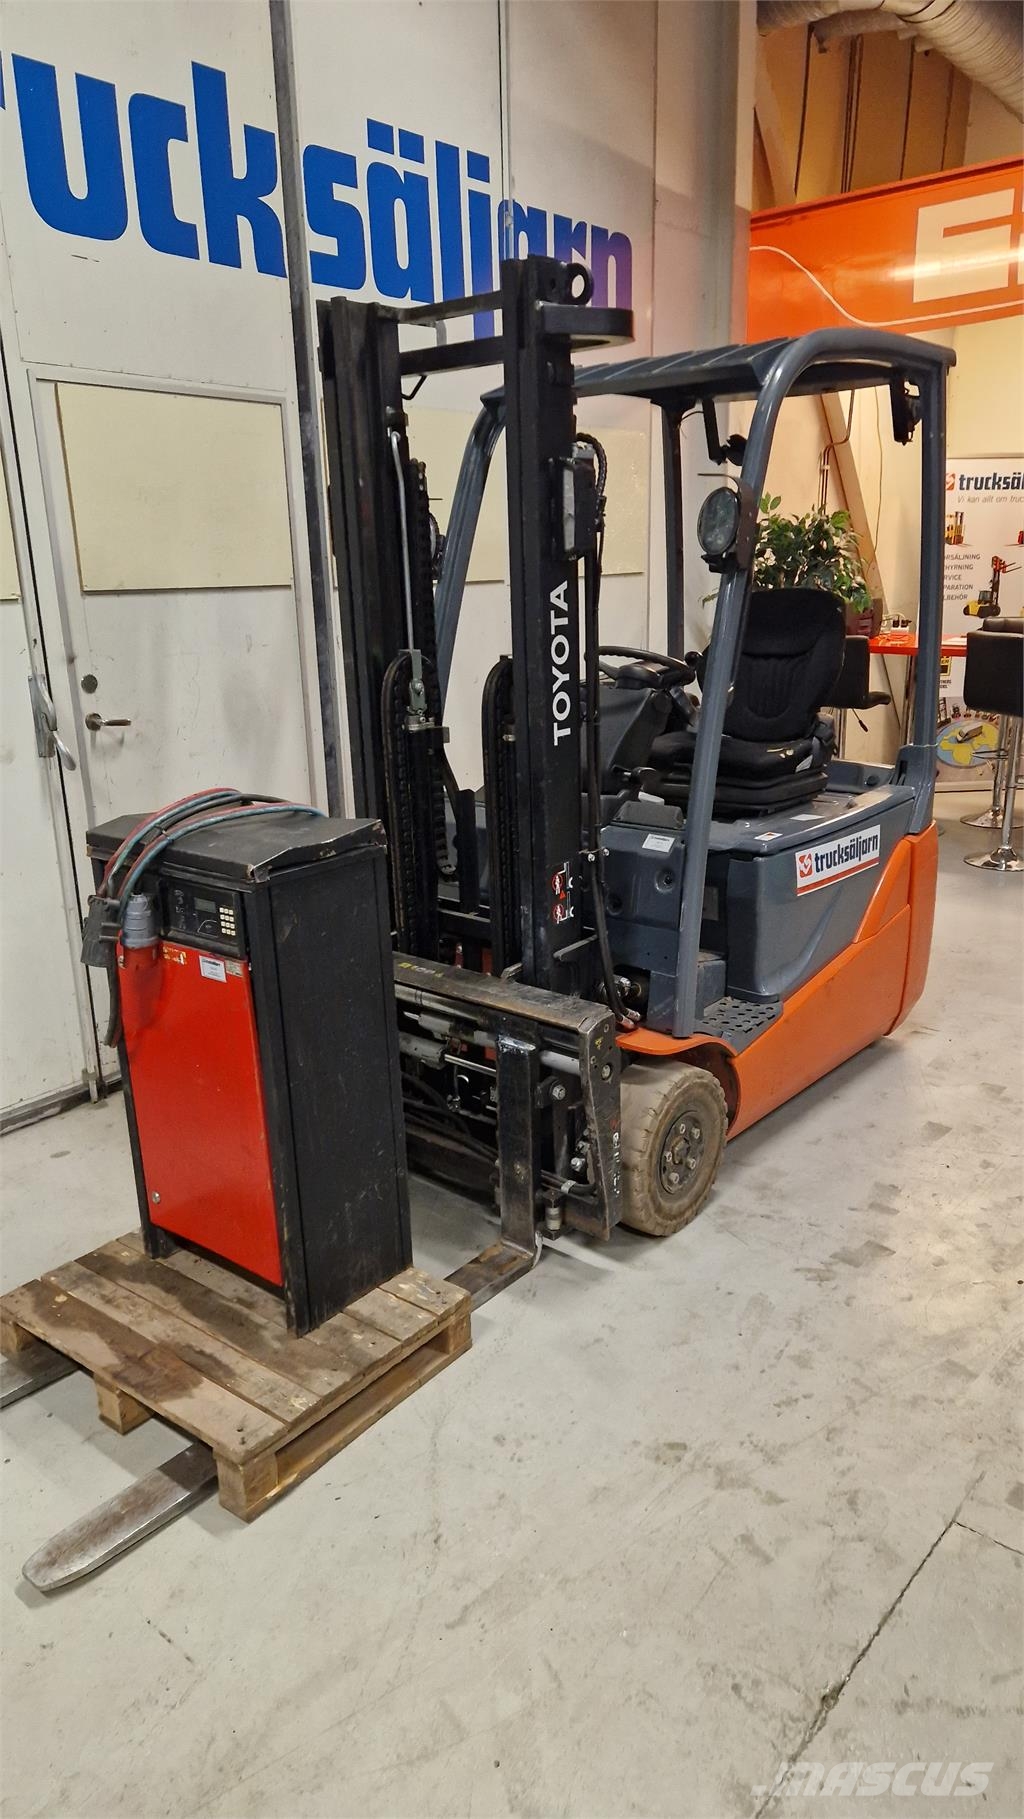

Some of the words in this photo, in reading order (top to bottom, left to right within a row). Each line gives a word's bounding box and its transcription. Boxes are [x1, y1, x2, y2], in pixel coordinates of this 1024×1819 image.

[0, 50, 632, 339] ucksäljarn
[913, 188, 1024, 303] E
[944, 563, 974, 571] HYRNING
[945, 552, 981, 561] RSÄLJNING
[550, 580, 572, 746] TOYOTA
[814, 834, 878, 873] trucksäljarn
